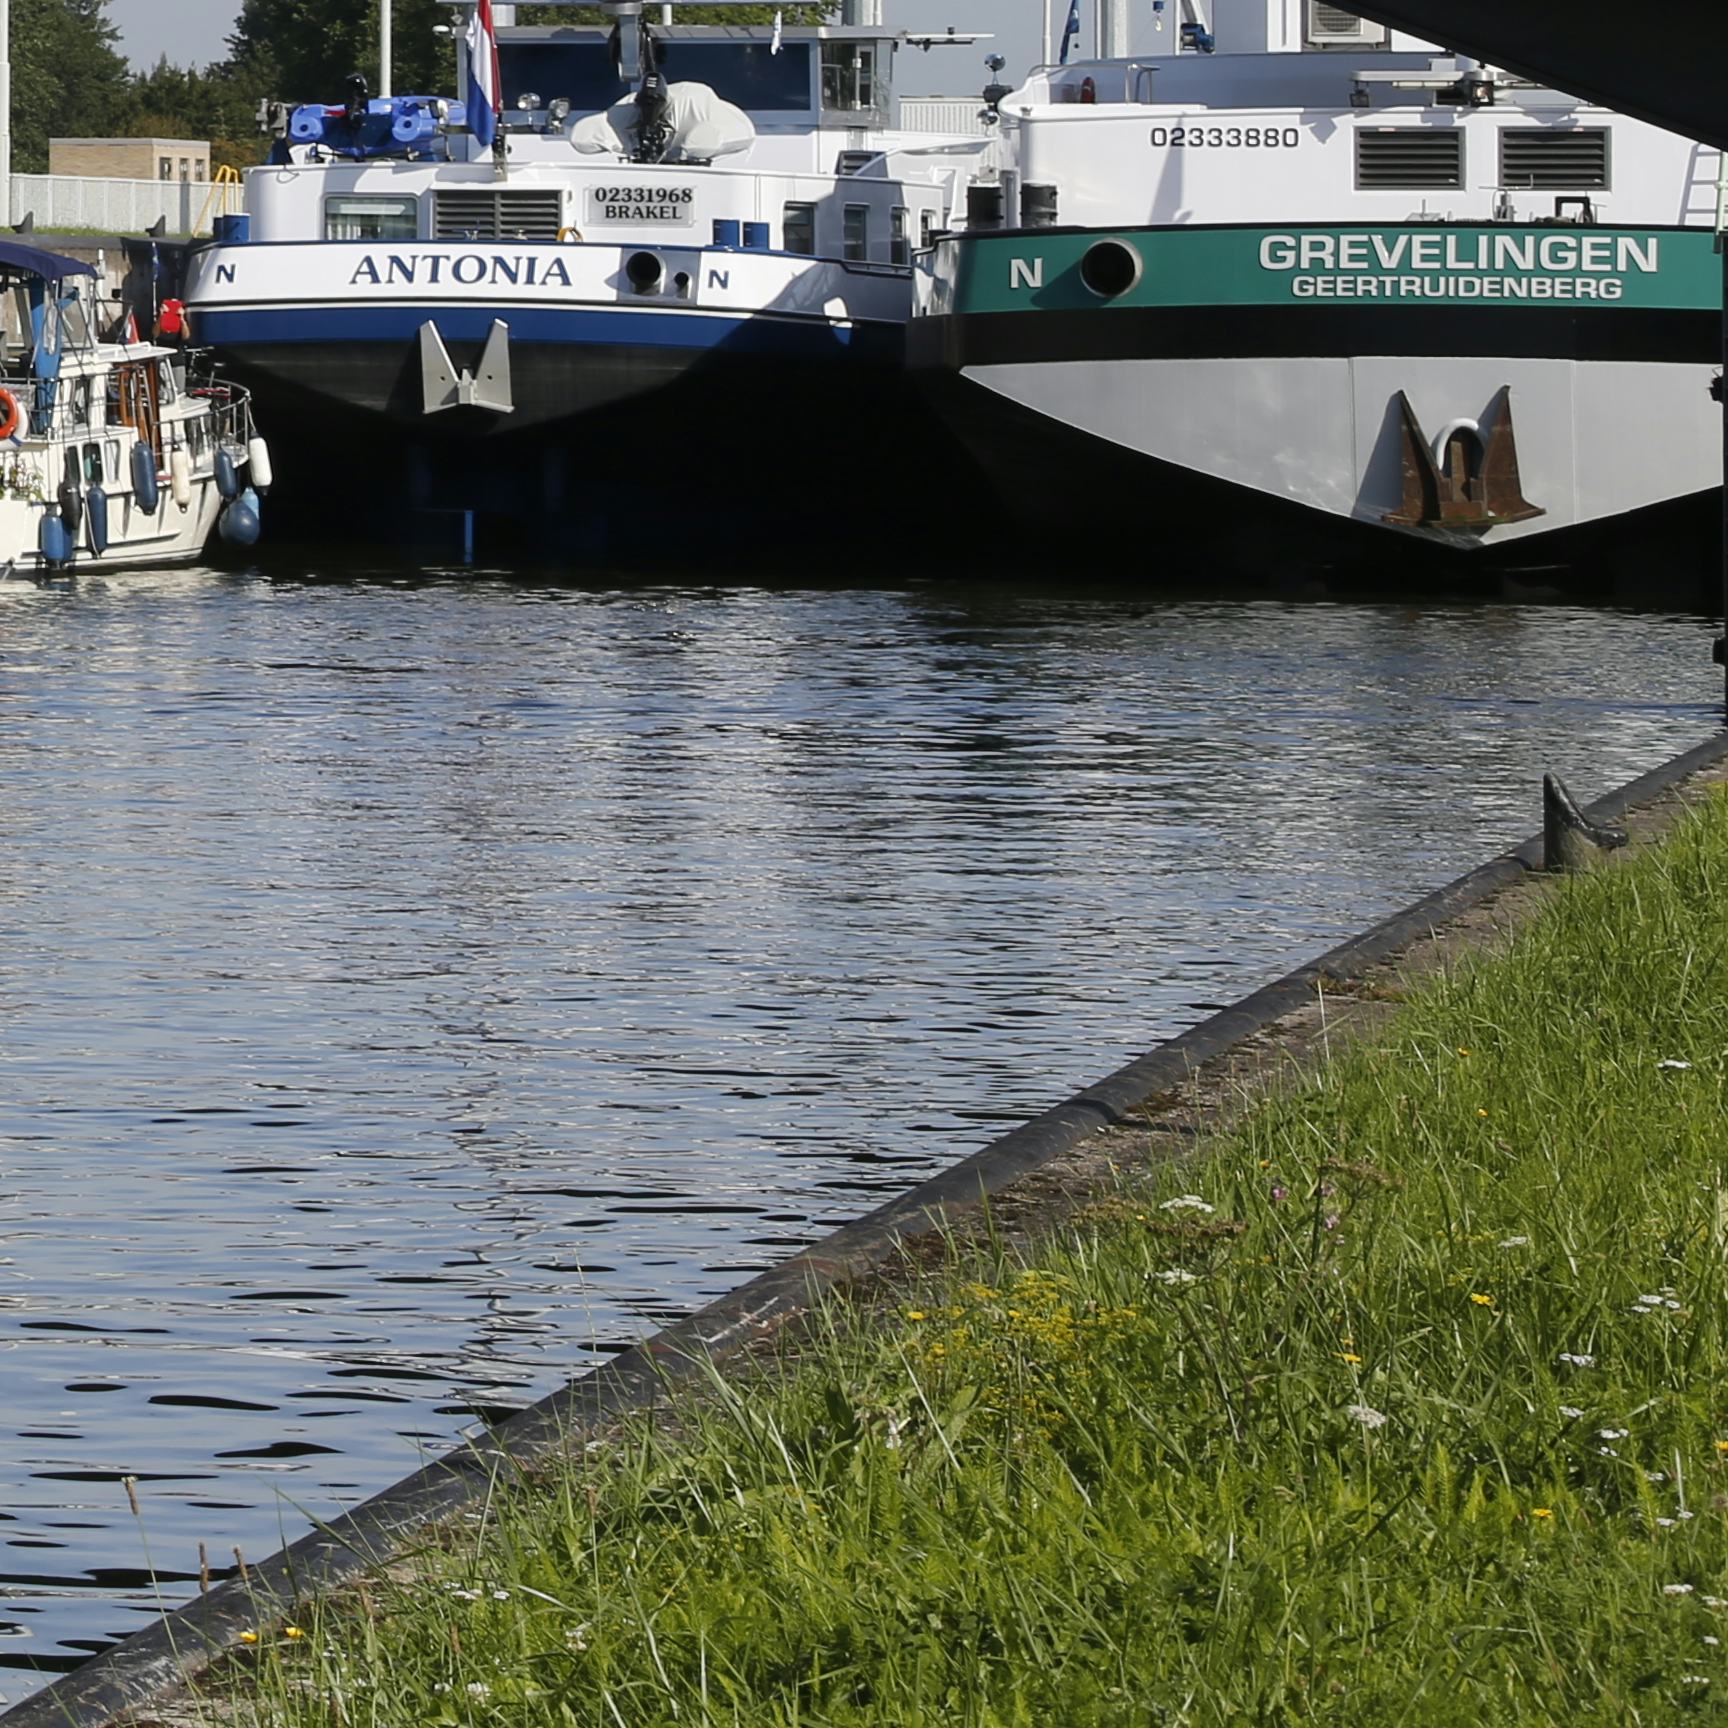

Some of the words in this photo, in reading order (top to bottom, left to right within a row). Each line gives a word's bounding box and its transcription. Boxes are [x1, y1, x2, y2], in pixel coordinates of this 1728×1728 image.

[1150, 127, 1300, 148] 02333880
[594, 186, 693, 204] 02331968
[604, 204, 683, 220] BRAKEL
[1257, 233, 1660, 273] GREVELINGEN
[214, 262, 237, 284] N
[348, 253, 574, 287] ANTONIA
[707, 268, 730, 290] N
[1008, 257, 1043, 288] N
[1290, 274, 1624, 300] GEERTRUIDENBERG
